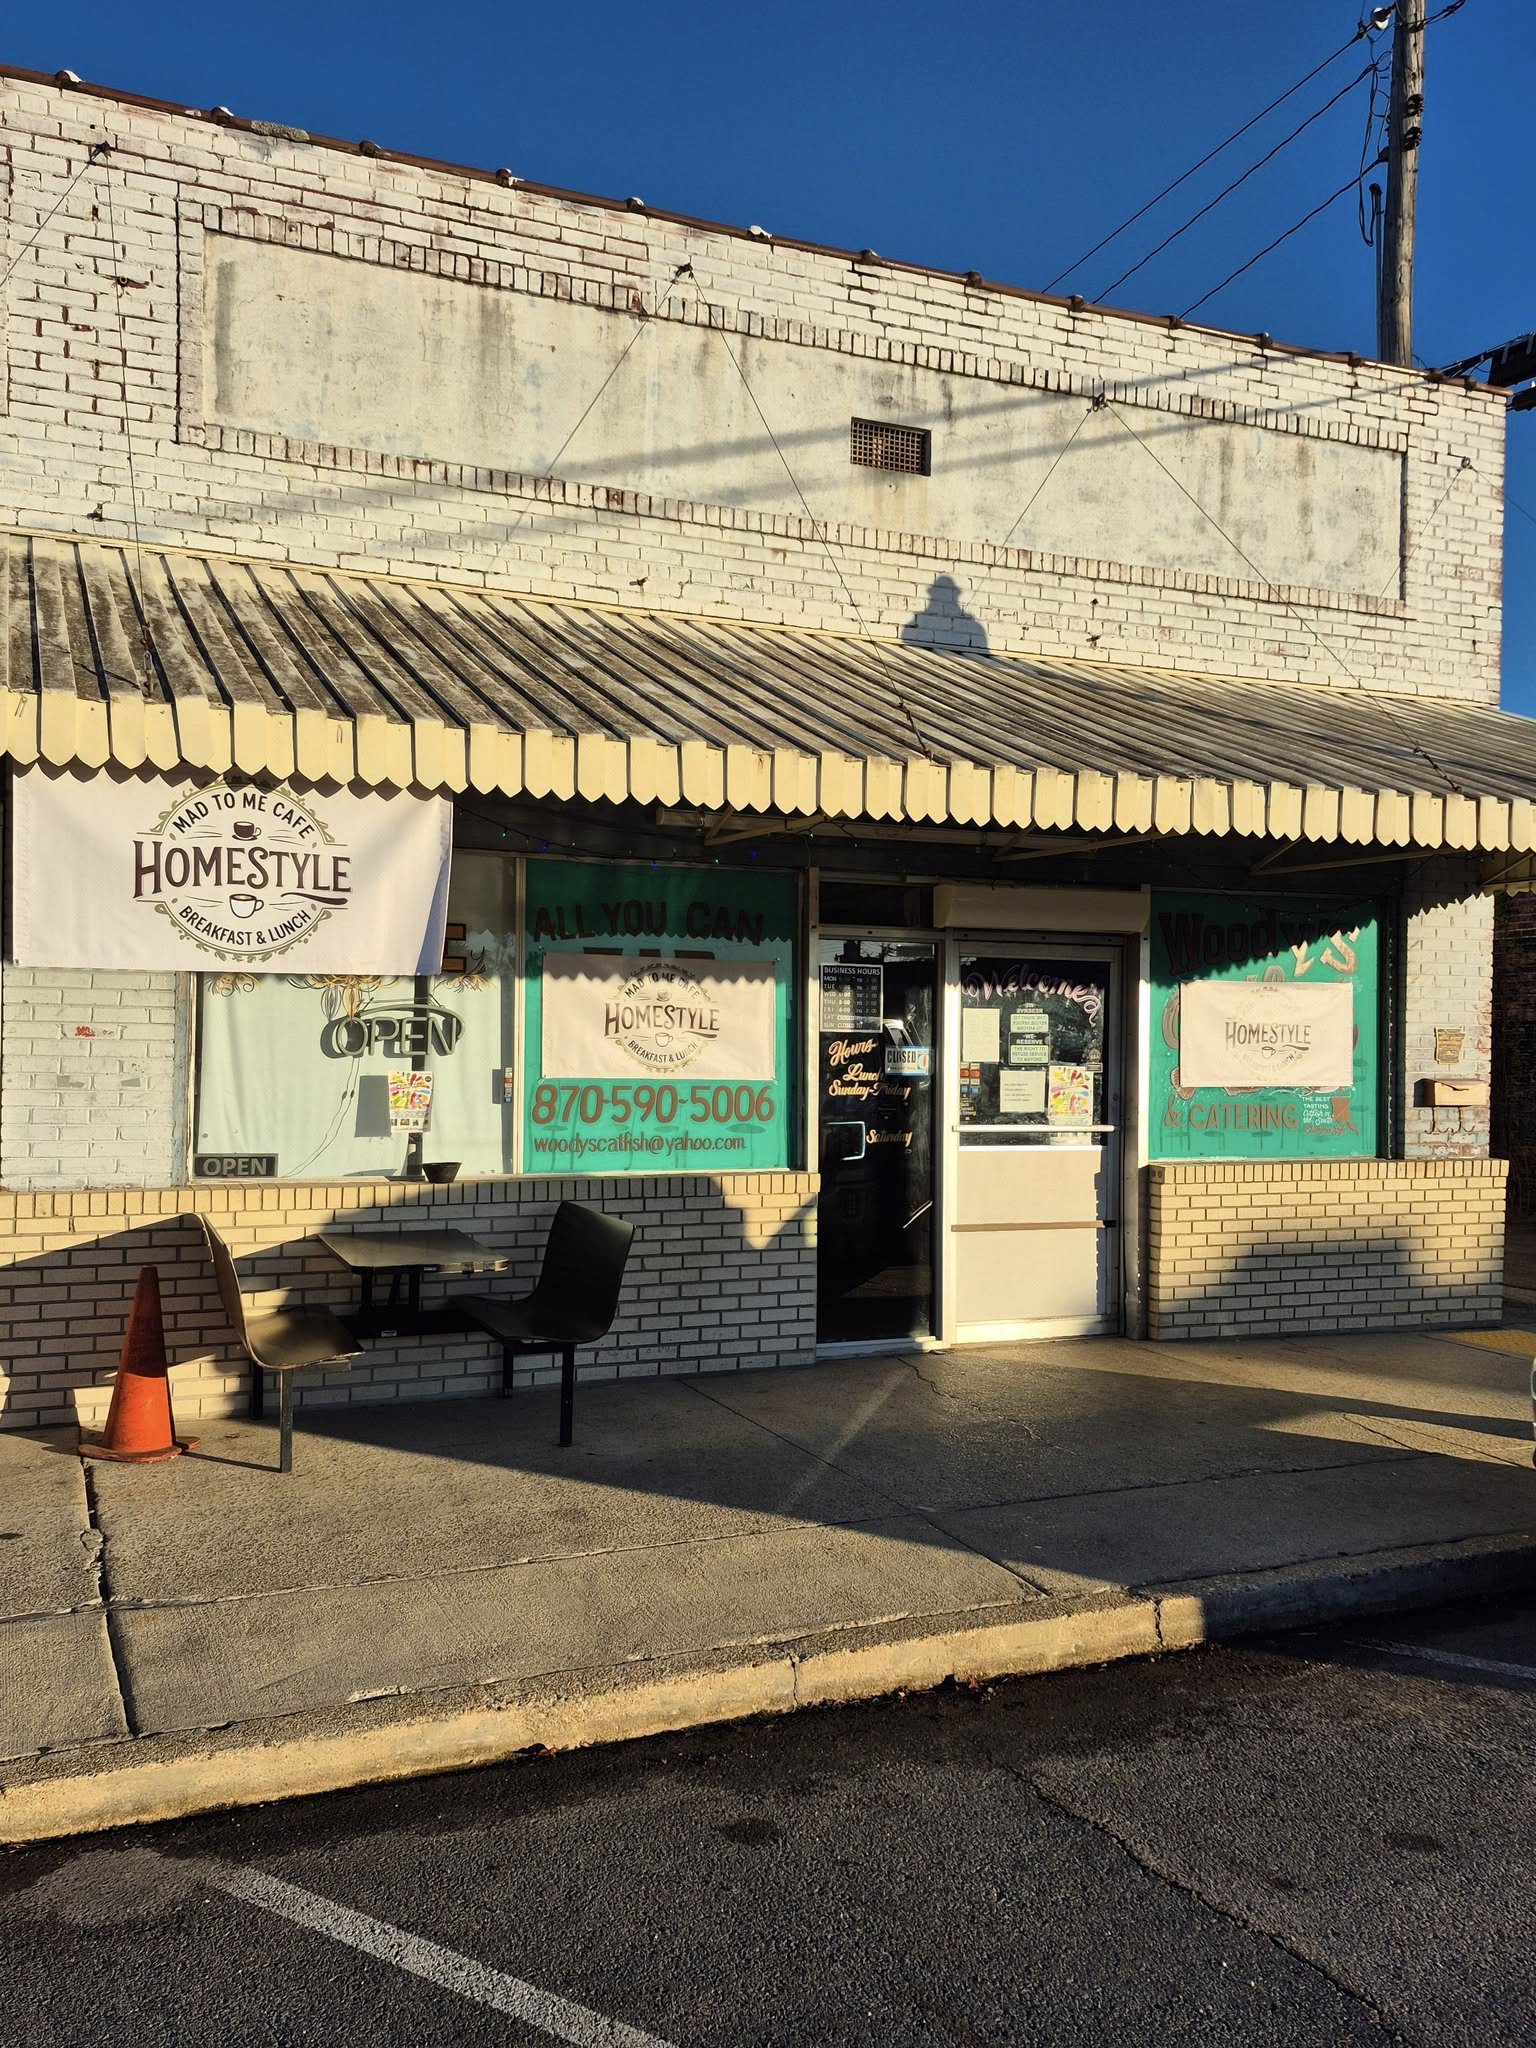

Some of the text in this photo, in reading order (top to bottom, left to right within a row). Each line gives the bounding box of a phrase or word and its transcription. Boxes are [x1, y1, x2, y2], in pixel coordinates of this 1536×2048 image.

[172, 792, 316, 840] MAD TO ME CAFE
[132, 840, 351, 899] HOMESTYLE
[179, 905, 312, 946] BREAKFAST & LUNCH
[534, 900, 763, 946] ALL YOU CAN
[624, 972, 700, 999] MAD TO ME CAFE
[857, 968, 881, 976] HOURS
[961, 963, 1100, 1027] Welcome
[604, 1003, 720, 1036] HOMESTYLE
[336, 1017, 457, 1056] OPEN
[1225, 1021, 1311, 1050] HOMESTYLE
[628, 1040, 667, 1063] BREAKFAST
[668, 1054, 674, 1062] &
[828, 1039, 878, 1066] Hours
[887, 1050, 917, 1063] CLOSED
[532, 1084, 775, 1125] 870-590-5006
[828, 1080, 911, 1100] Sunday-Friday
[1164, 1094, 1299, 1130] & CATERING
[534, 1129, 745, 1158] woodyscatfish@yahoo.com
[866, 1130, 913, 1147] Saturday
[203, 1157, 267, 1177] OPEN
